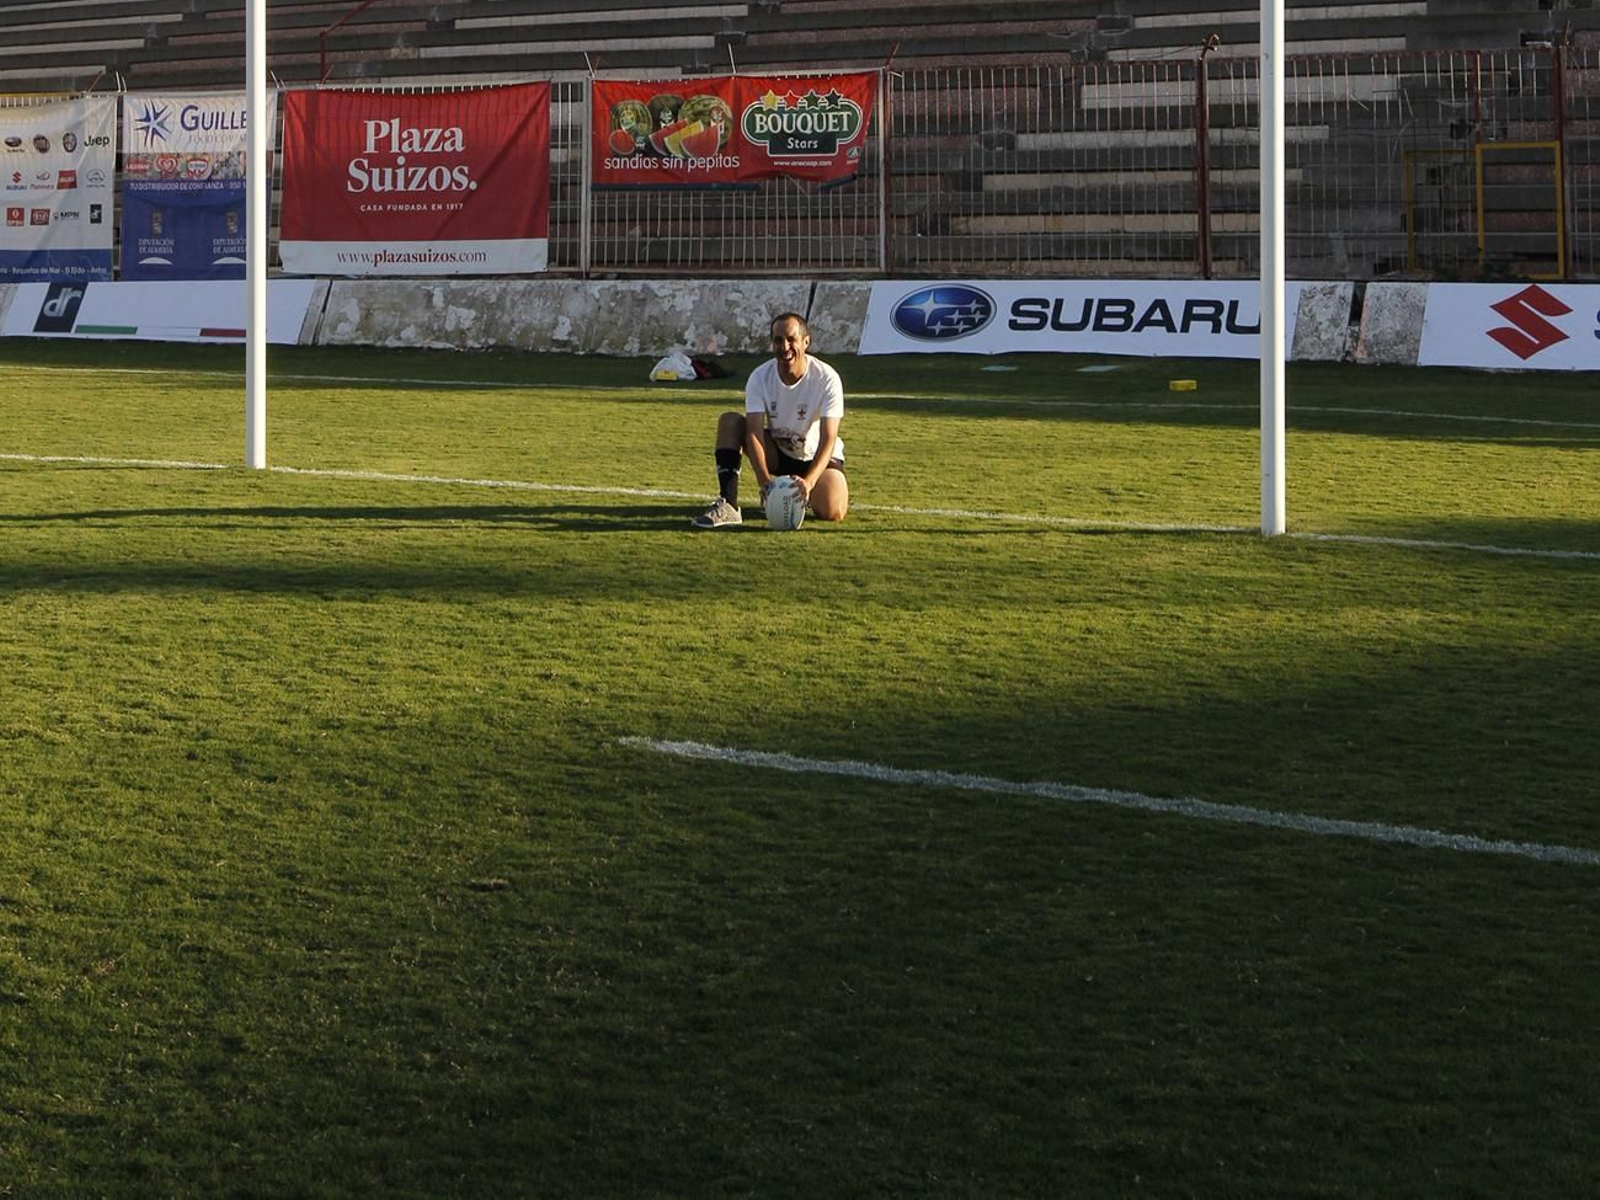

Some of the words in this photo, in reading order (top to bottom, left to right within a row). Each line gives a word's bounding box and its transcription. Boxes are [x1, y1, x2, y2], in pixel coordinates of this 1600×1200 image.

[180, 104, 247, 132] GUILLE
[754, 111, 853, 135] BOUQUET
[363, 118, 465, 154] Plaza
[787, 137, 818, 149] Stars
[604, 153, 658, 170] sandías
[662, 152, 683, 169] sin
[687, 151, 740, 171] pepitas
[347, 156, 478, 193] Suizos.
[360, 204, 383, 212] CASA
[337, 249, 487, 267] www.plazasuizos.com
[1008, 298, 1261, 335] SUBARU
